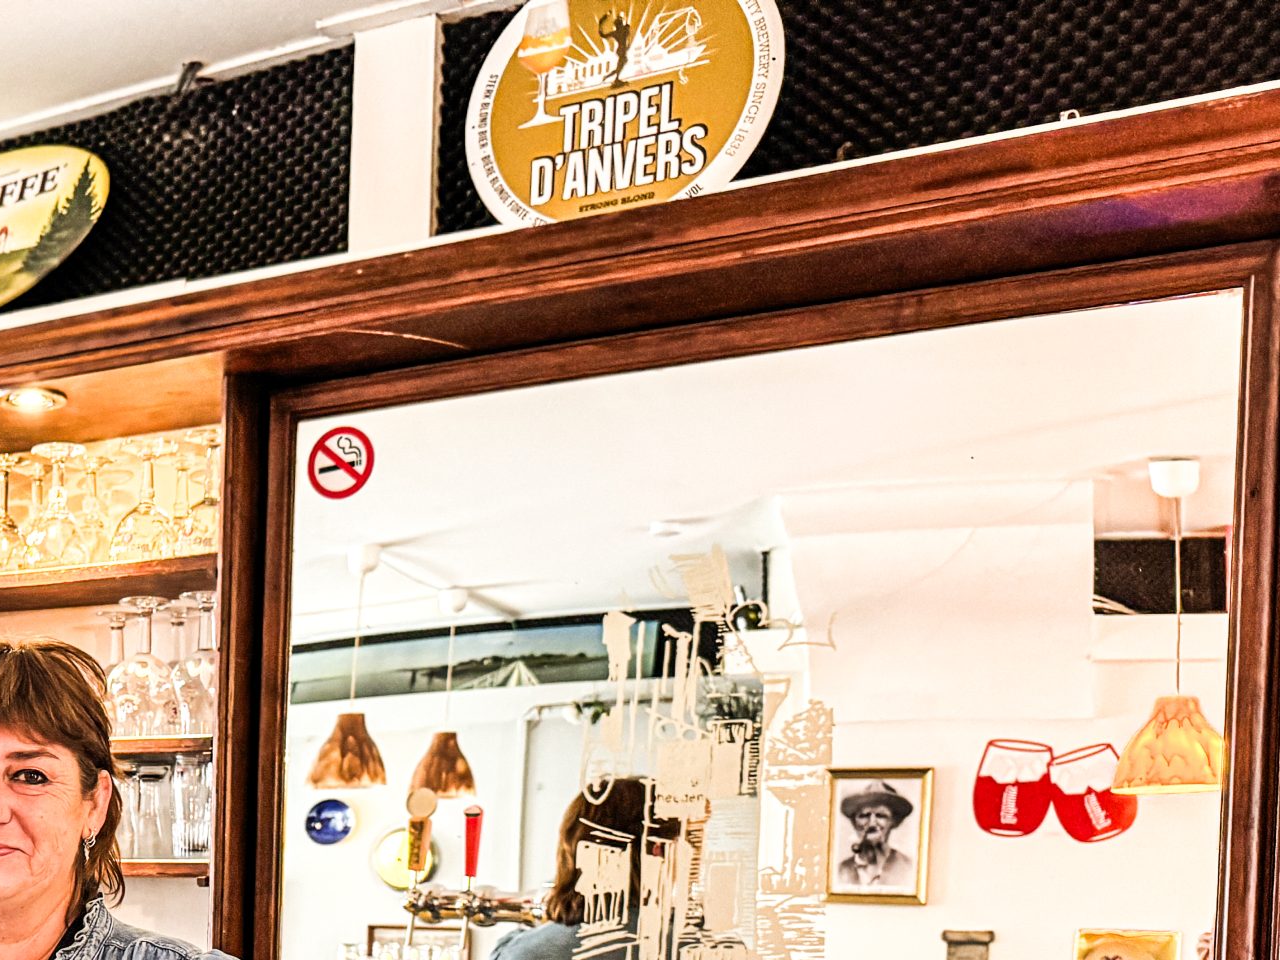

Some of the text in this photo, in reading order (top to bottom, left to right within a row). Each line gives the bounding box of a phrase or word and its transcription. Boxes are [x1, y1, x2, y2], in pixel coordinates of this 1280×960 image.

[754, 17, 771, 80] BREWERY
[559, 81, 682, 153] TRIPEL
[743, 82, 767, 125] SINCE
[478, 102, 491, 129] BLOND
[489, 175, 512, 203] BLONDE
[506, 200, 530, 222] FORTE
[530, 123, 708, 206] D'ANVERS
[725, 127, 749, 157] 1833
[578, 191, 656, 213] STRONG BLOND
